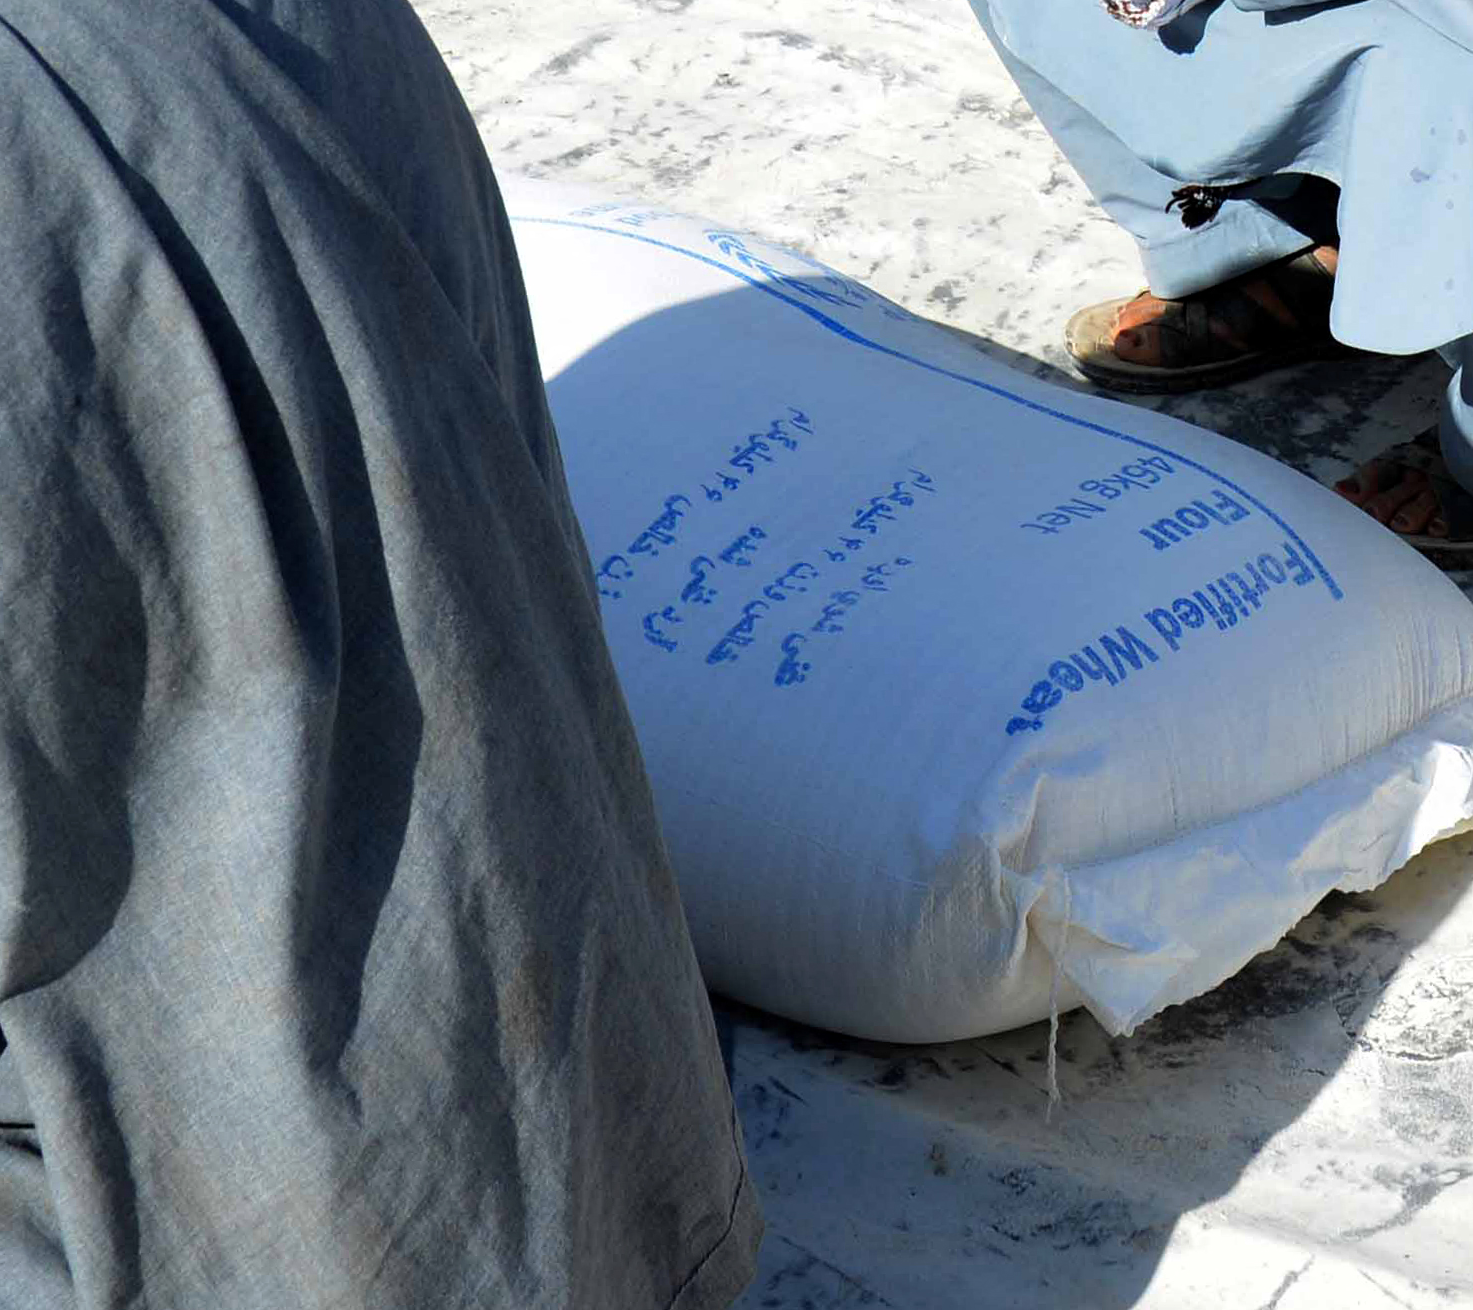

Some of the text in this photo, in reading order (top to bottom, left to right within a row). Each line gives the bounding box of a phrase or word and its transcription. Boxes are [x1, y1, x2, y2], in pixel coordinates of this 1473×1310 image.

[596, 553, 634, 601] زن
[627, 493, 693, 557] خالص
[1020, 456, 1176, 535] 46kg Net
[1138, 488, 1252, 552] Flour
[642, 604, 684, 653] آرد
[718, 525, 768, 567] شده
[705, 600, 770, 665] خالص
[763, 561, 820, 602] وزن
[1004, 540, 1316, 737] Fortified Wheat
